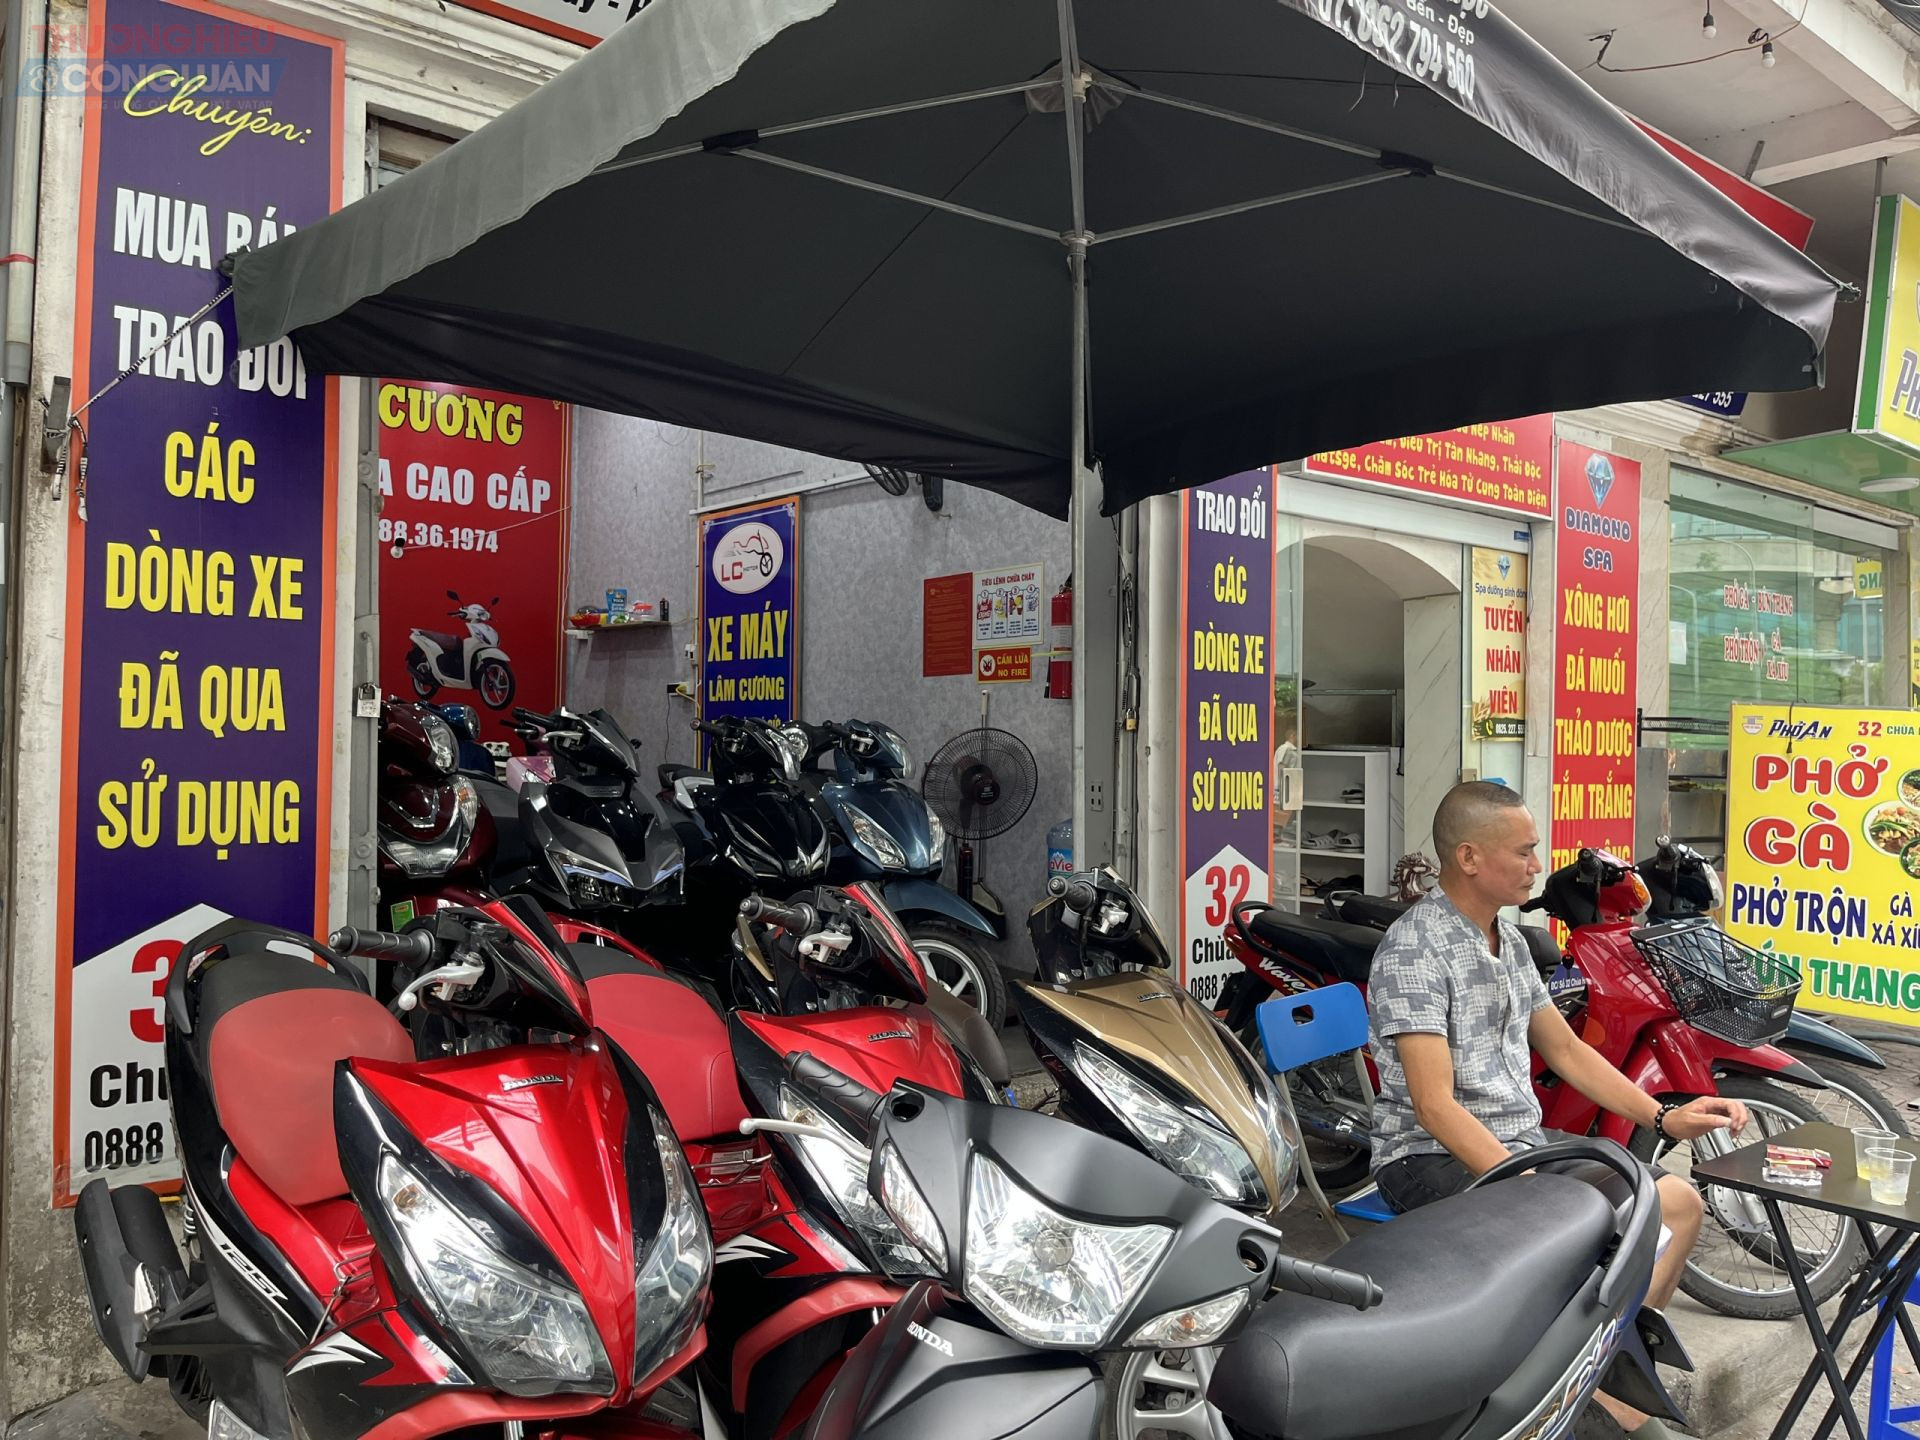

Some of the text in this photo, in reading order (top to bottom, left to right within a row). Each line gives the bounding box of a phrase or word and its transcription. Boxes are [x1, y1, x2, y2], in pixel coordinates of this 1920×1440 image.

[1407, 21, 1443, 82] 794
[1448, 14, 1475, 45] Đẹp
[123, 69, 312, 155] Chuyên:
[113, 187, 211, 270] MUA
[113, 304, 224, 386] TRAO
[378, 383, 523, 445] CƯƠNG
[1492, 425, 1515, 446] Nhăn
[164, 421, 256, 504] CÁC
[1365, 454, 1392, 476] Chăm
[1395, 460, 1415, 481] Sóc
[1417, 464, 1437, 485] Trẻ
[1439, 469, 1458, 490] Hóa
[1476, 478, 1500, 500] Cung
[1502, 483, 1525, 504] Toàn
[1527, 488, 1547, 510] Diện
[1426, 438, 1442, 461] Trị
[1466, 446, 1499, 472] Nhang,
[1502, 454, 1522, 475] Thải
[1525, 460, 1541, 482] Độc
[406, 463, 474, 506] CAO
[487, 465, 551, 514] CẤP
[1196, 485, 1266, 539] TRAO ĐỔI
[105, 528, 304, 620] DÒNG XE
[721, 561, 743, 582] LC
[1214, 556, 1247, 605] CÁC
[1584, 547, 1612, 572] SPA
[707, 601, 788, 662] XE MÁY
[1484, 600, 1523, 633] TUYỂN
[1564, 583, 1630, 634] XÔNG HƠI
[1011, 668, 1027, 676] FIRE
[1194, 621, 1264, 675] DÒNG XE
[1486, 645, 1521, 673] NHÂN
[1566, 647, 1626, 695] ĐÁ MUỐI
[119, 650, 286, 738] ĐÃ QUA
[708, 675, 785, 702] LÂM CƯƠNG
[1489, 686, 1518, 714] VIÊN
[1199, 693, 1258, 746] ĐÃ QUA
[1555, 707, 1633, 765] THẢO DƯỢC
[1858, 721, 1882, 737] 32
[1887, 723, 1915, 735] CHÙA
[1192, 758, 1263, 819] SỬ DỤNG
[1553, 770, 1633, 820] TẮM TRẮNG
[1754, 744, 1889, 798] PHỞ
[97, 758, 301, 860] SỬ DỤNG
[1746, 802, 1850, 871] GÀ
[1205, 864, 1250, 927] 32
[1731, 876, 1866, 944] PHỞ TRỘN
[1890, 892, 1913, 918] GÀ
[1872, 921, 1896, 947] XÁ
[1190, 974, 1217, 1001] 0888
[1259, 957, 1313, 991] Wave
[1809, 958, 1920, 1010] THANG
[85, 1121, 163, 1173] 0888
